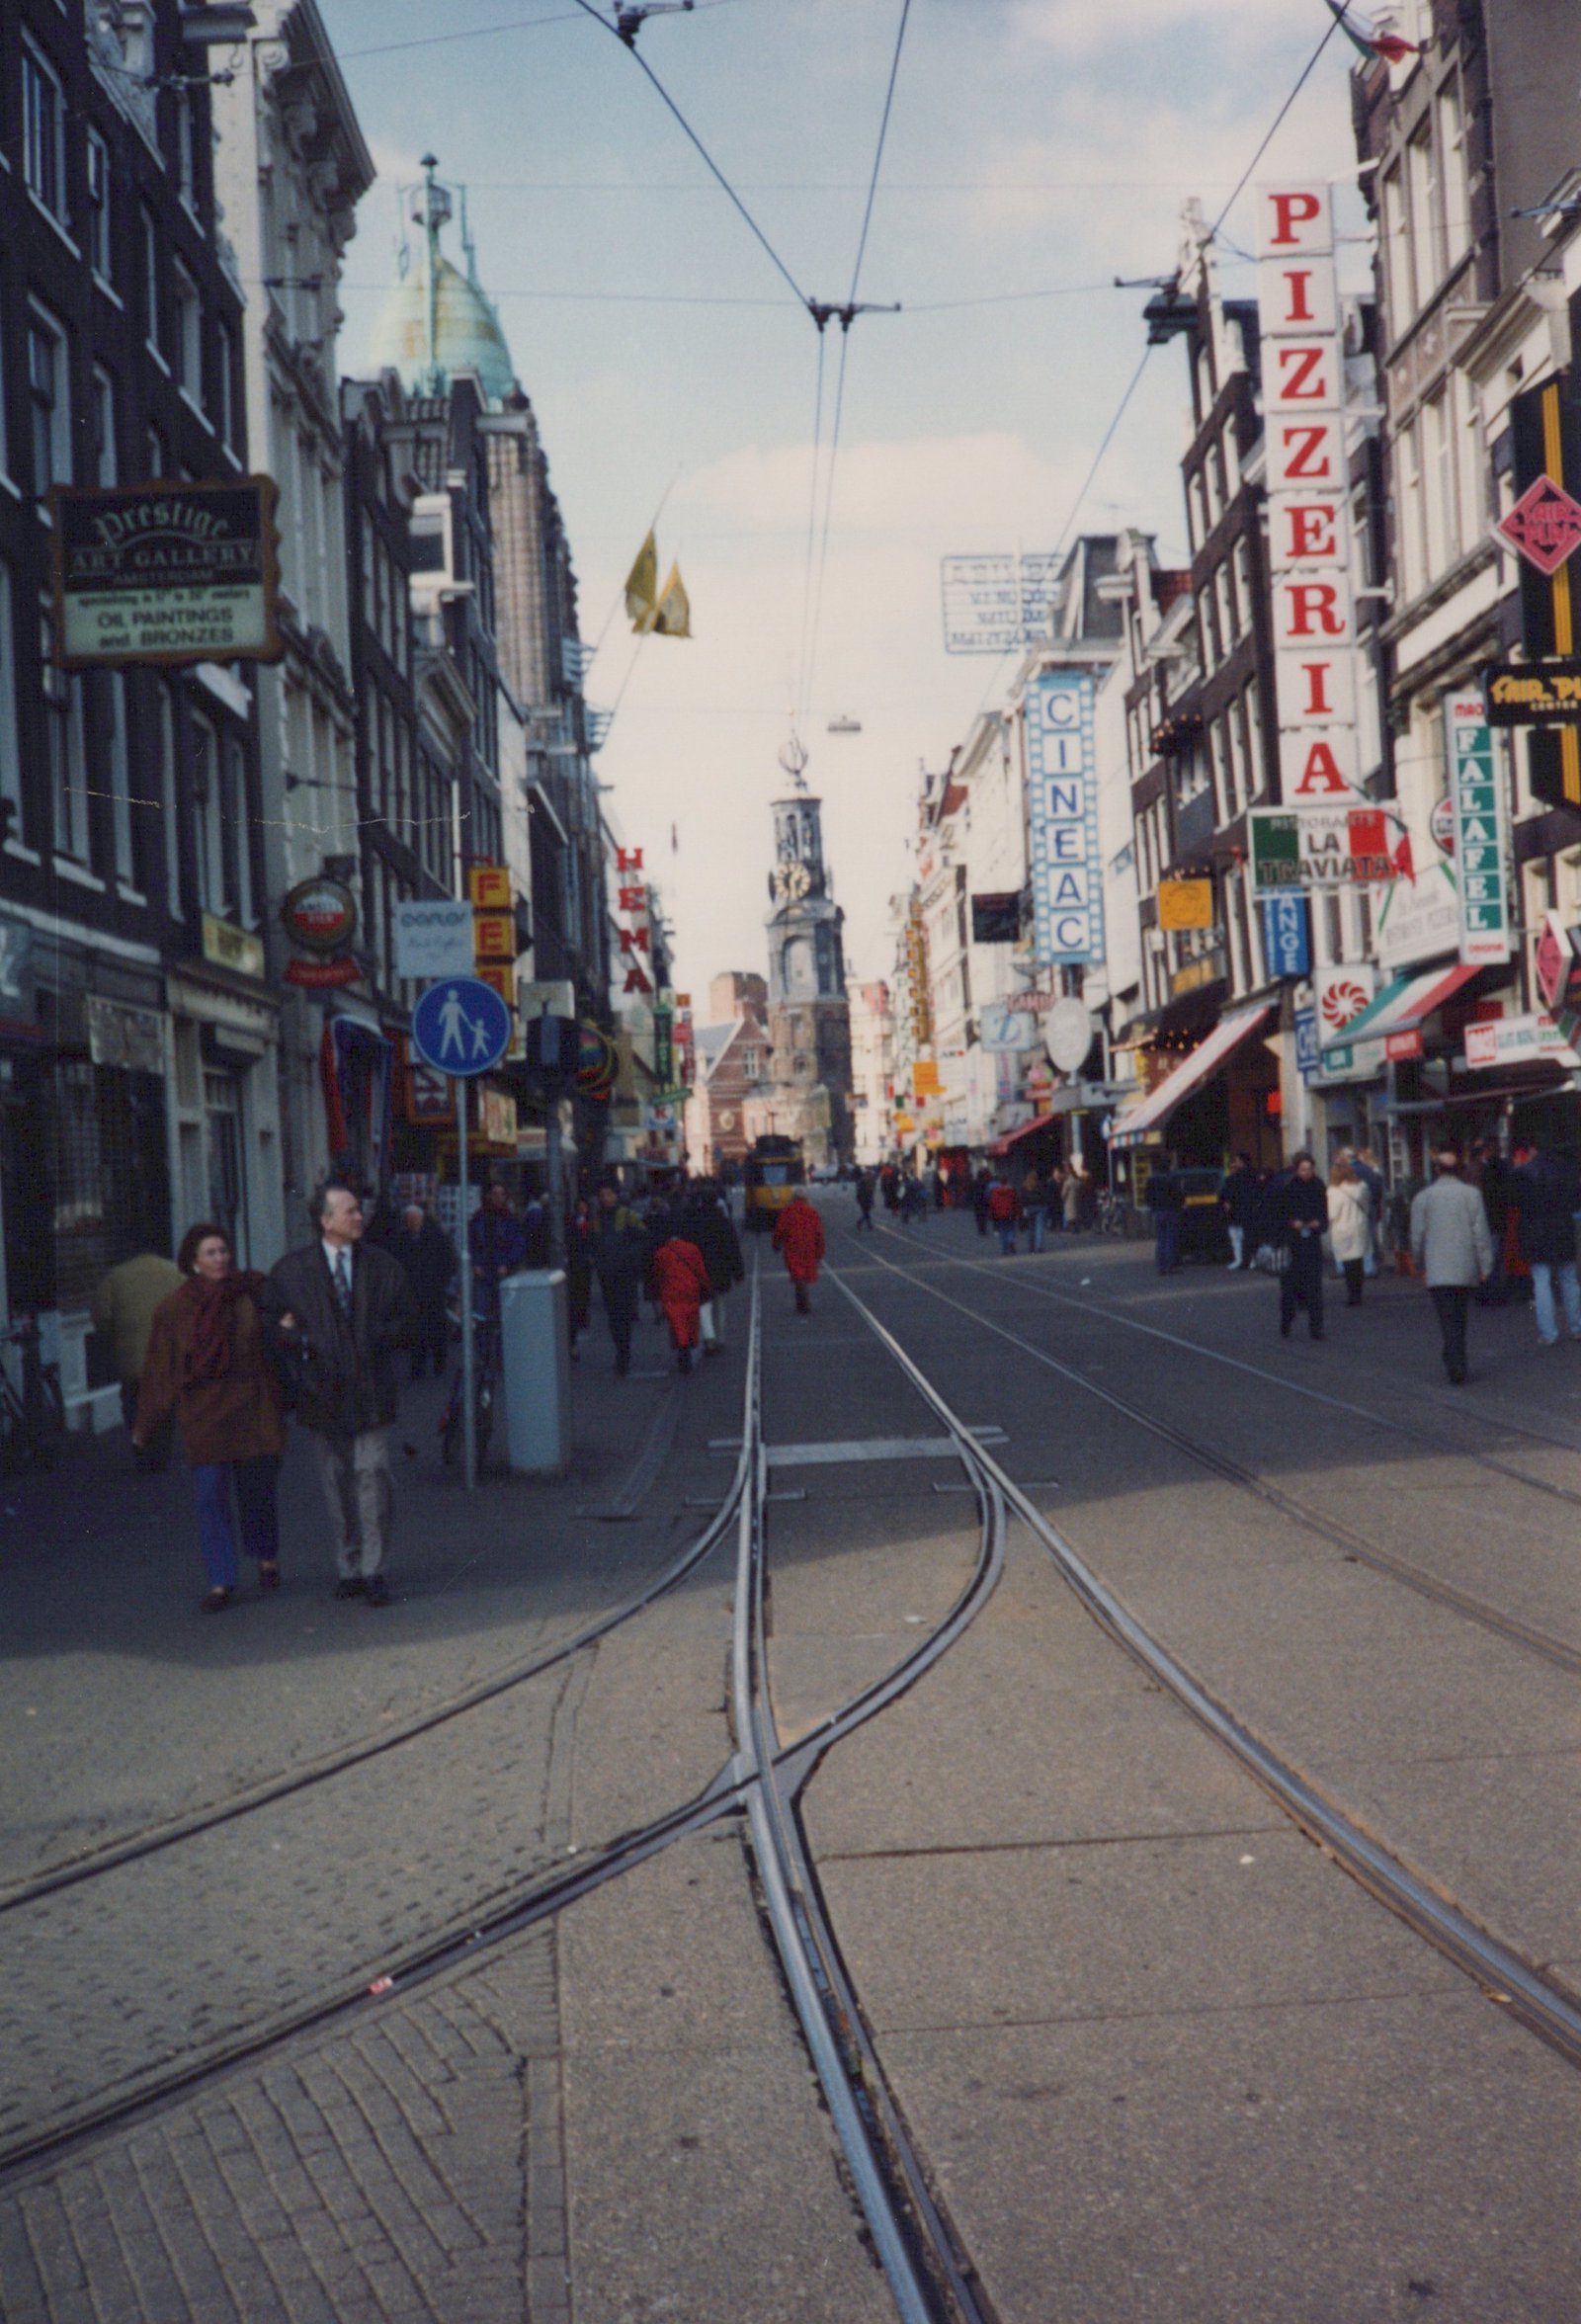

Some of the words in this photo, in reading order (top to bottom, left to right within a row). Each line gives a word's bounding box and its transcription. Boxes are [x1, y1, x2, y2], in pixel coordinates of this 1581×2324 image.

[1269, 192, 1350, 794] PIZZERIA
[72, 551, 122, 569] ART
[134, 545, 253, 568] GALLERY
[97, 612, 124, 628] OIL
[131, 607, 234, 625] PAINTINGS
[139, 626, 234, 646] BRONZES
[1046, 694, 1084, 949] CINEAC
[1457, 728, 1489, 930] FALAFEL
[1307, 832, 1341, 854] LA
[1259, 855, 1391, 883] TRAVIATA
[616, 847, 653, 994] HEMA
